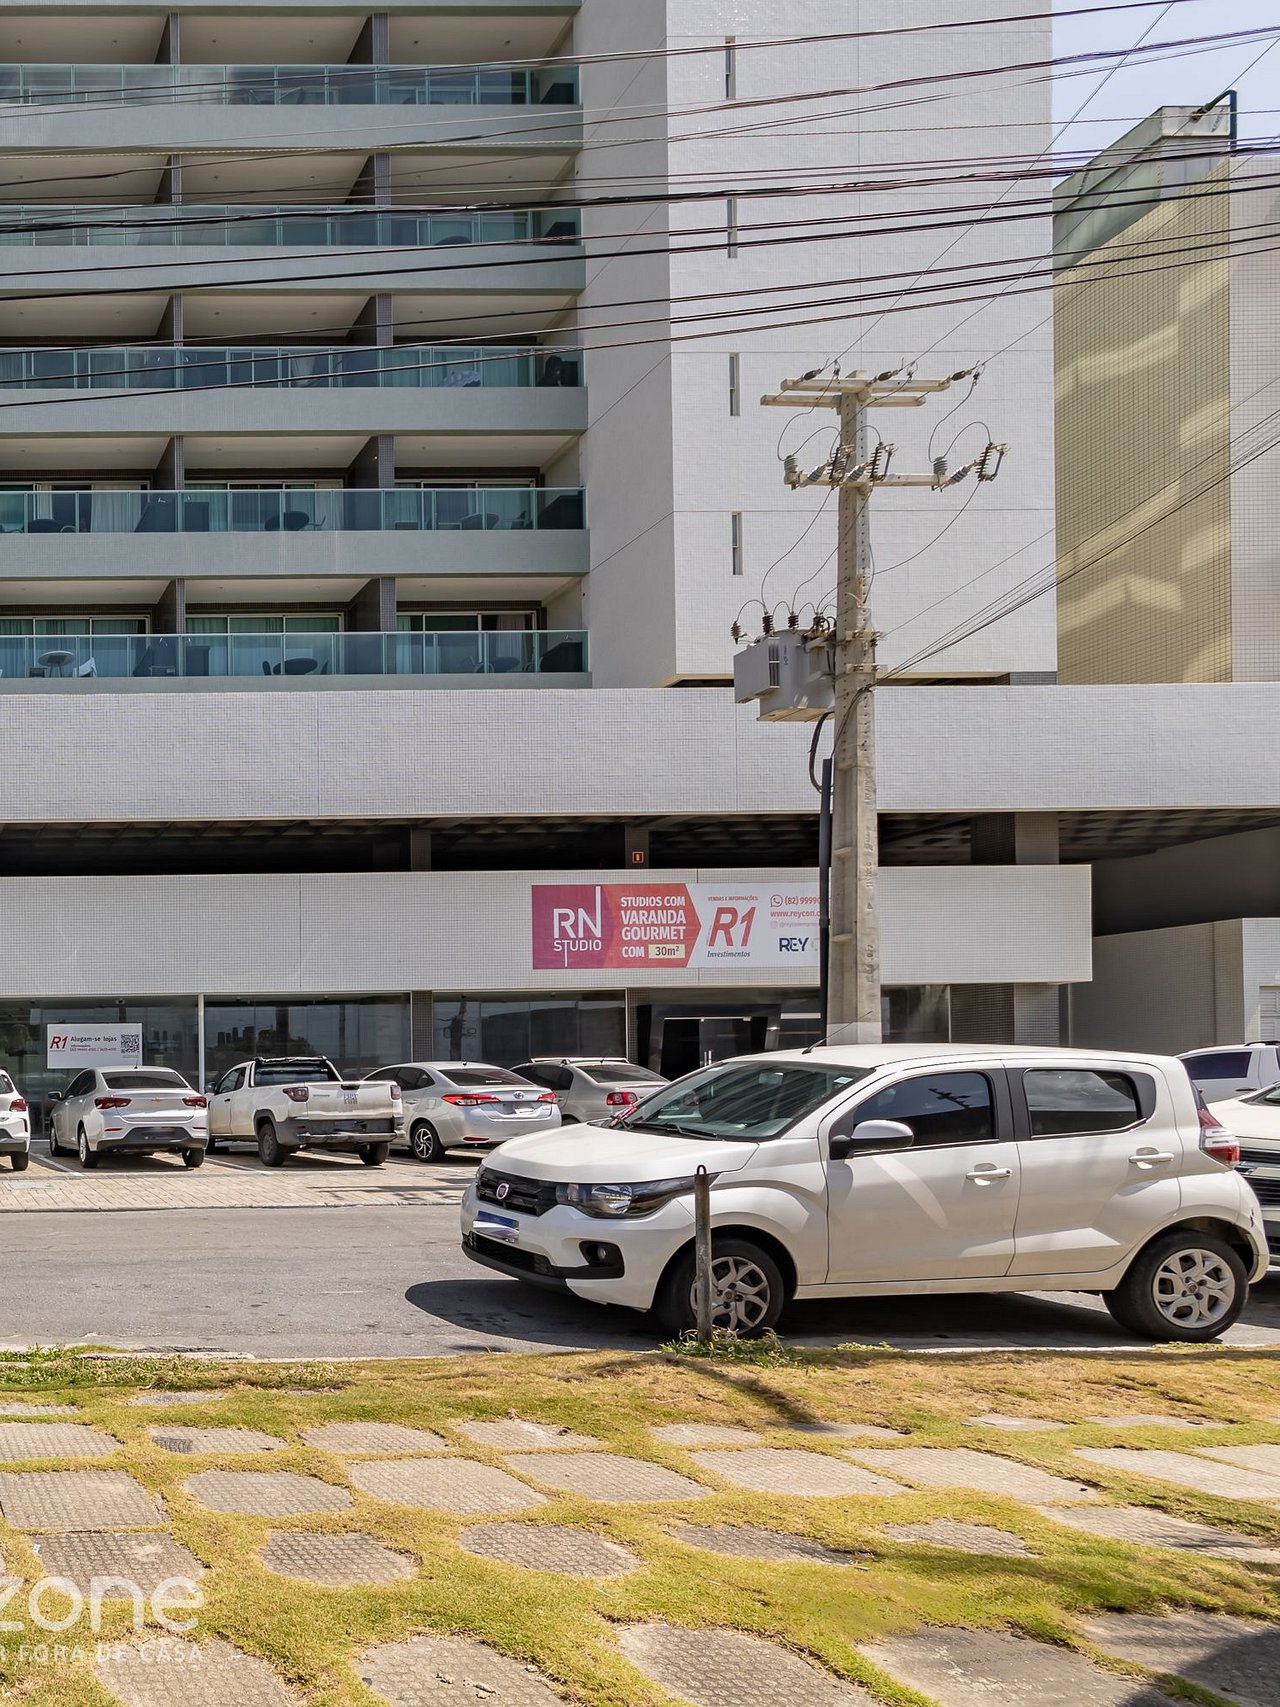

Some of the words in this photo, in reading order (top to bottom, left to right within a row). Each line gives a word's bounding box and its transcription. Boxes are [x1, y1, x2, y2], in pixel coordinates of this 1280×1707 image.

[621, 897, 662, 907] STUDIOS
[664, 896, 685, 907] COM
[784, 896, 798, 905] (82)
[553, 886, 602, 938] RN
[621, 909, 686, 925] VARANDA
[621, 926, 686, 941] GOURMET
[708, 907, 756, 946] R1
[622, 946, 645, 958] COM
[655, 945, 680, 956] 30m²
[779, 937, 809, 952] REY
[553, 940, 602, 967] STUDIO
[707, 950, 751, 958] Investimentos
[50, 1036, 68, 1049] R1
